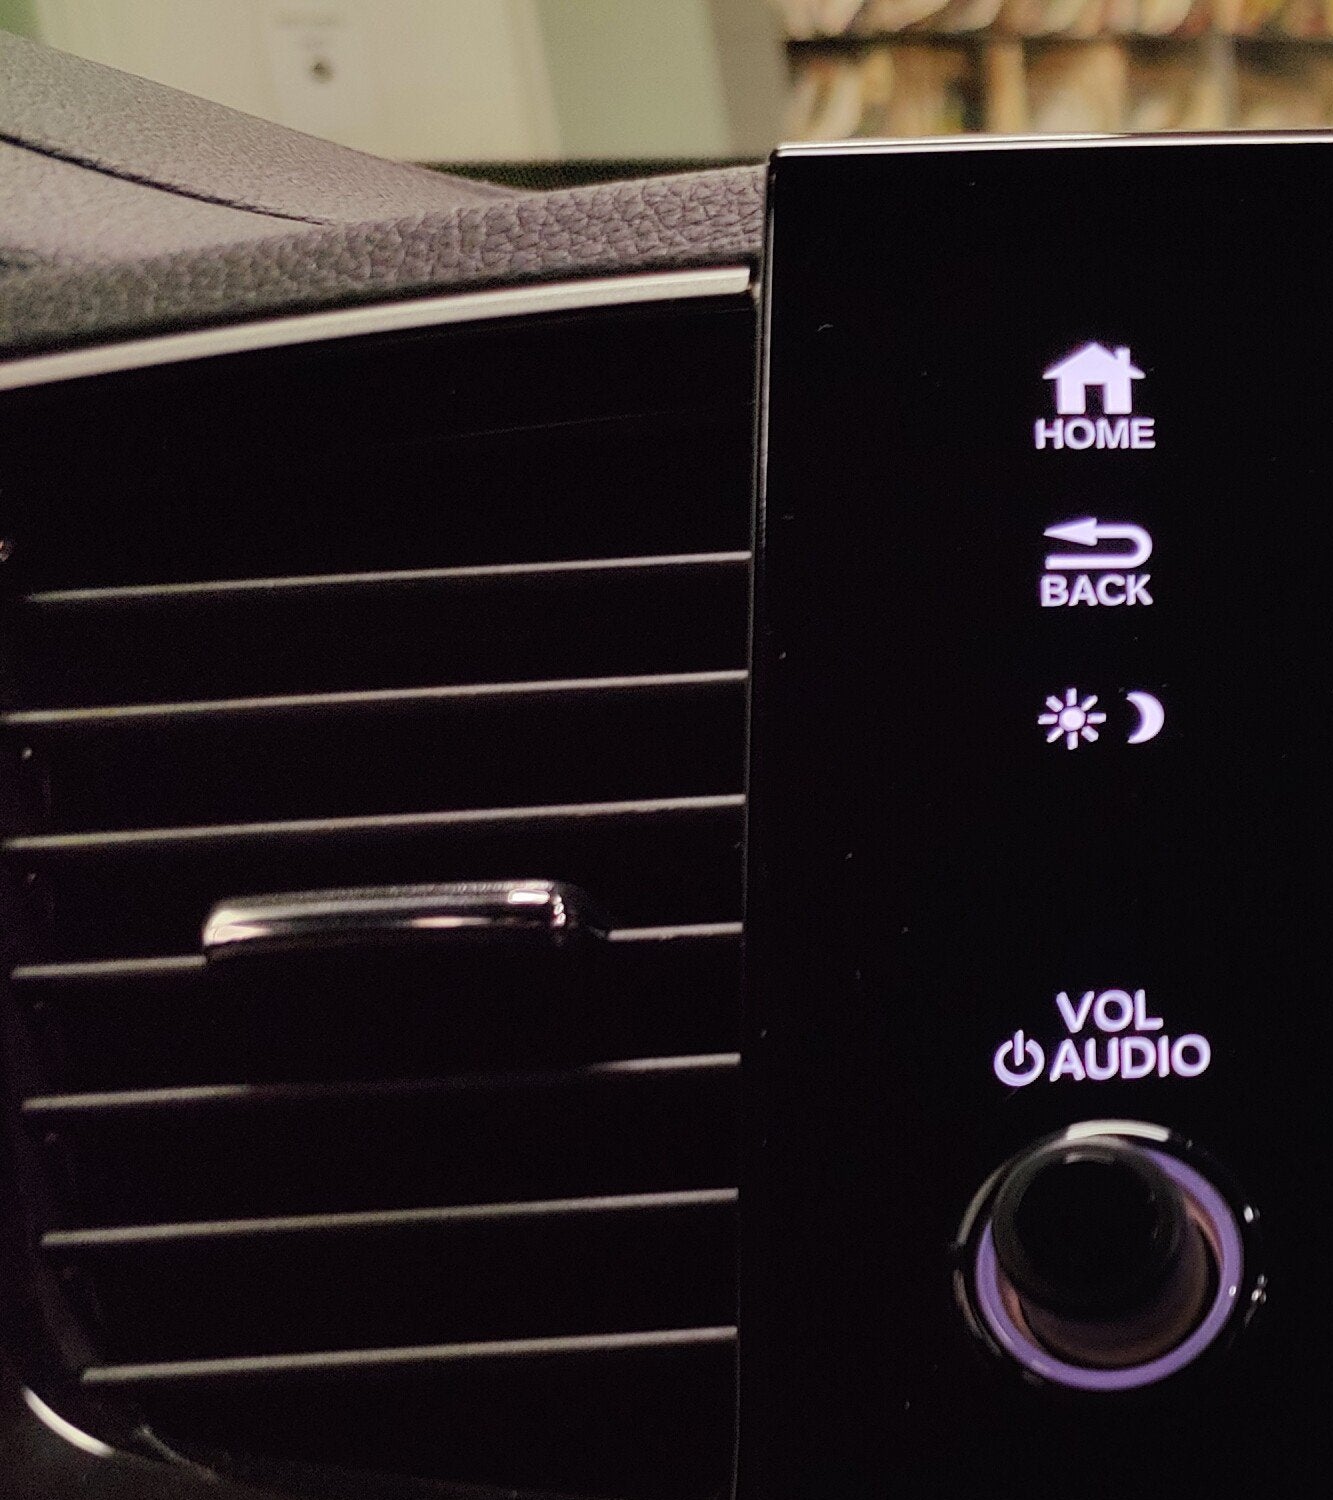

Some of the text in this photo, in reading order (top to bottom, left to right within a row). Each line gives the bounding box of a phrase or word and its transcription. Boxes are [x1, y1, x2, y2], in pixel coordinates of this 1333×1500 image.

[1034, 418, 1156, 450] HOME
[1039, 573, 1155, 607] BACK
[1055, 988, 1165, 1034] VOL
[1049, 1033, 1212, 1083] AUDIO
